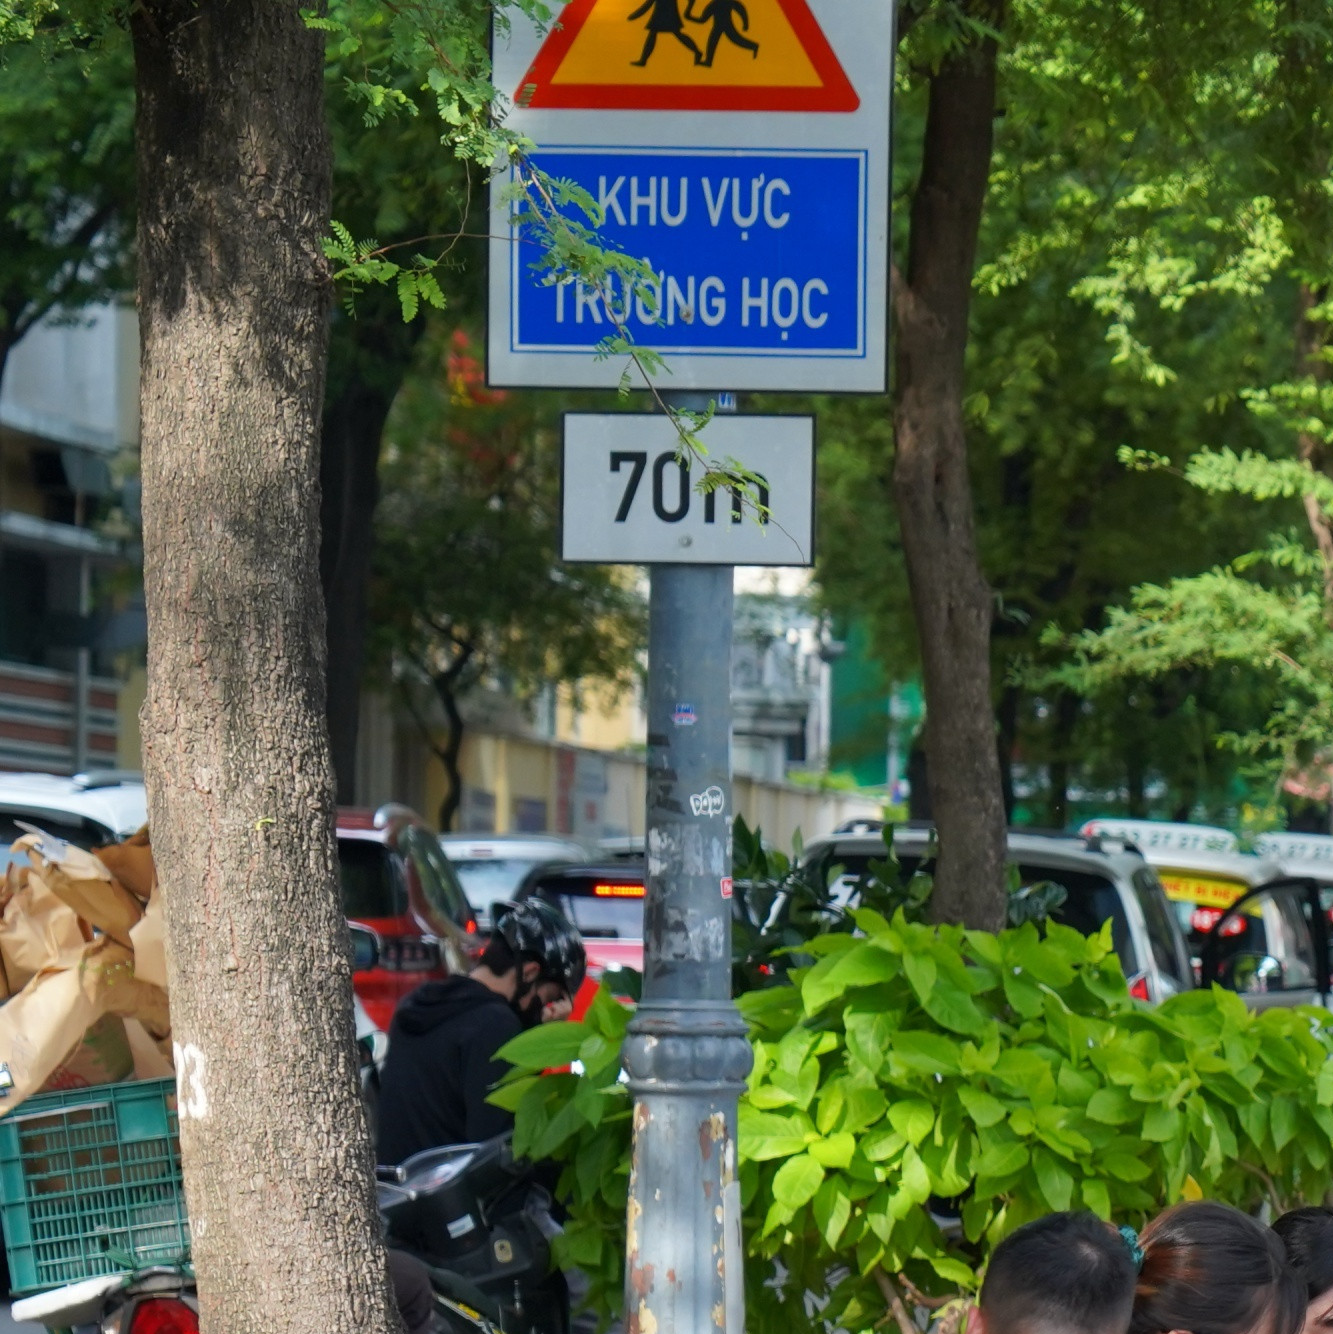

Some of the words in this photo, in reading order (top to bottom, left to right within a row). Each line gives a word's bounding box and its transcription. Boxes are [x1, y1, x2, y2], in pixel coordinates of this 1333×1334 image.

[599, 175, 689, 228] KHU
[701, 172, 791, 240] VỰC
[741, 276, 829, 340] HỌC
[609, 450, 771, 525] 70m
